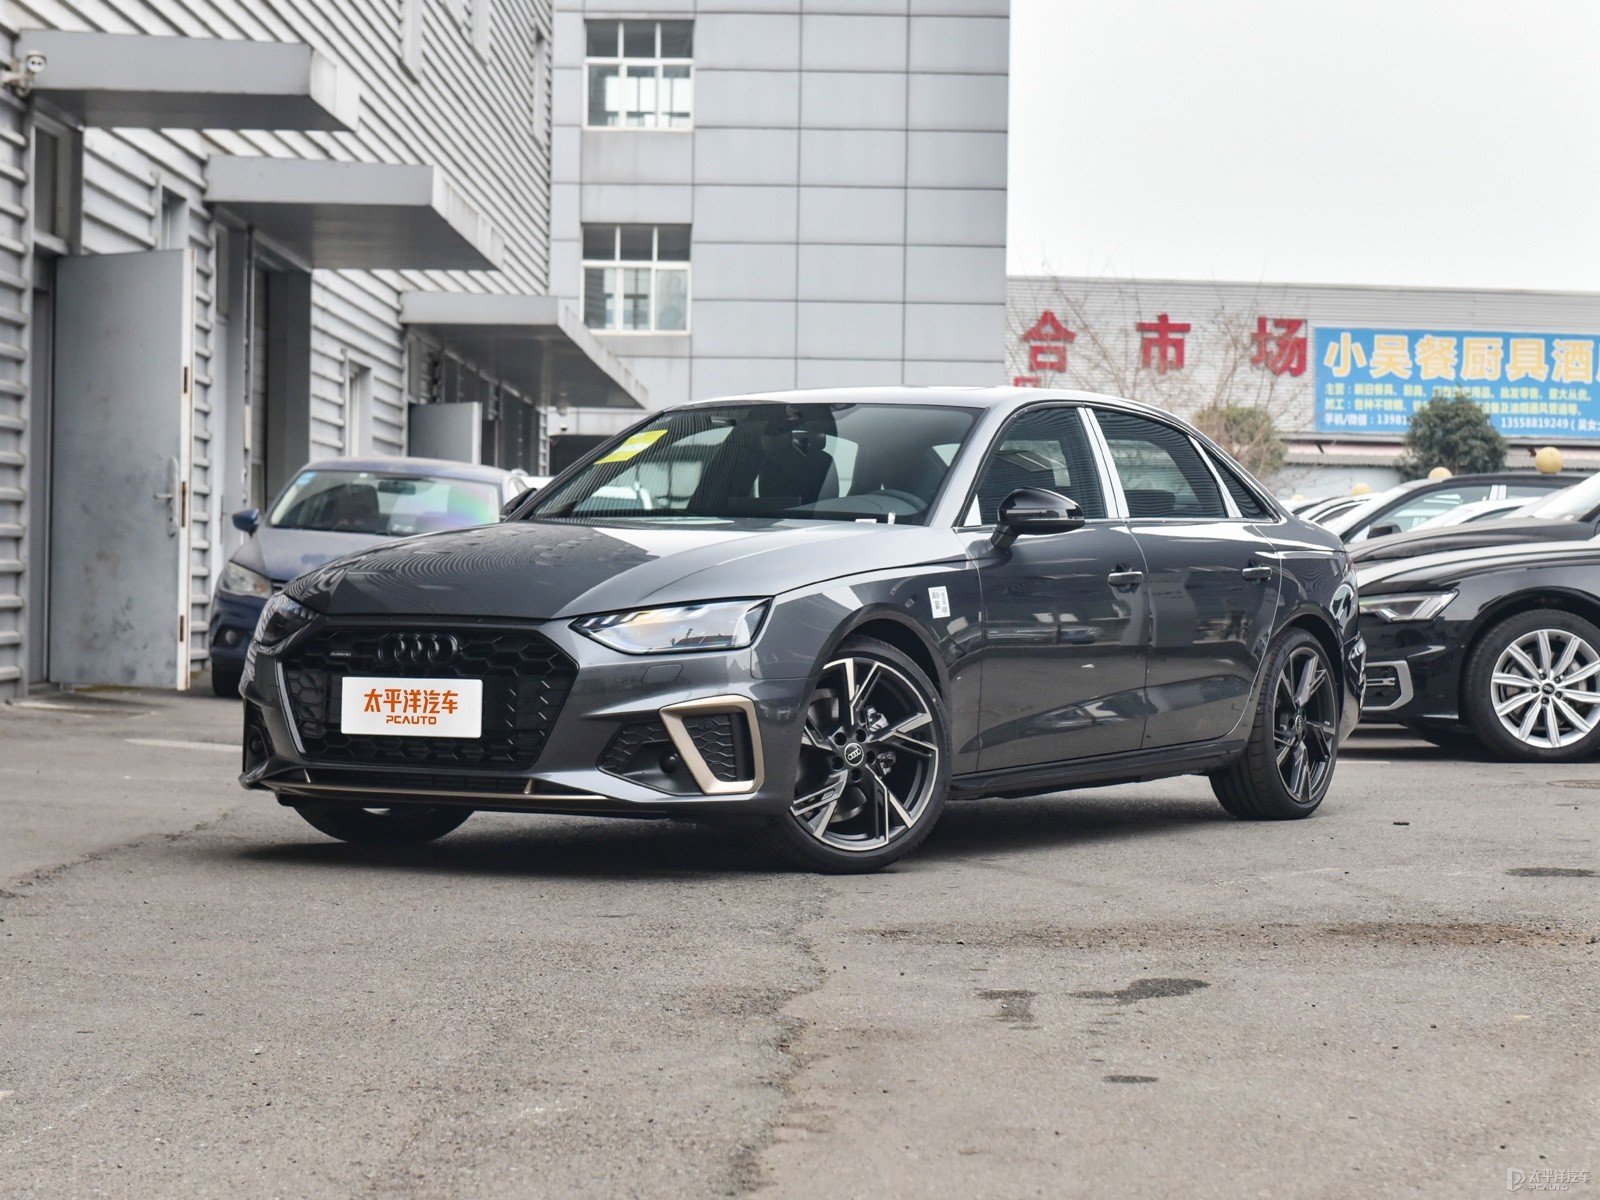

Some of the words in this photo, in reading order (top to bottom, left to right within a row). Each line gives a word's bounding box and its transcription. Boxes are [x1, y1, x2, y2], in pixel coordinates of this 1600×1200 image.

[1323, 332, 1600, 384] 小吴餐厨具酒
[364, 689, 459, 714] 太平洋汽车
[386, 715, 437, 725] PCAUTO
